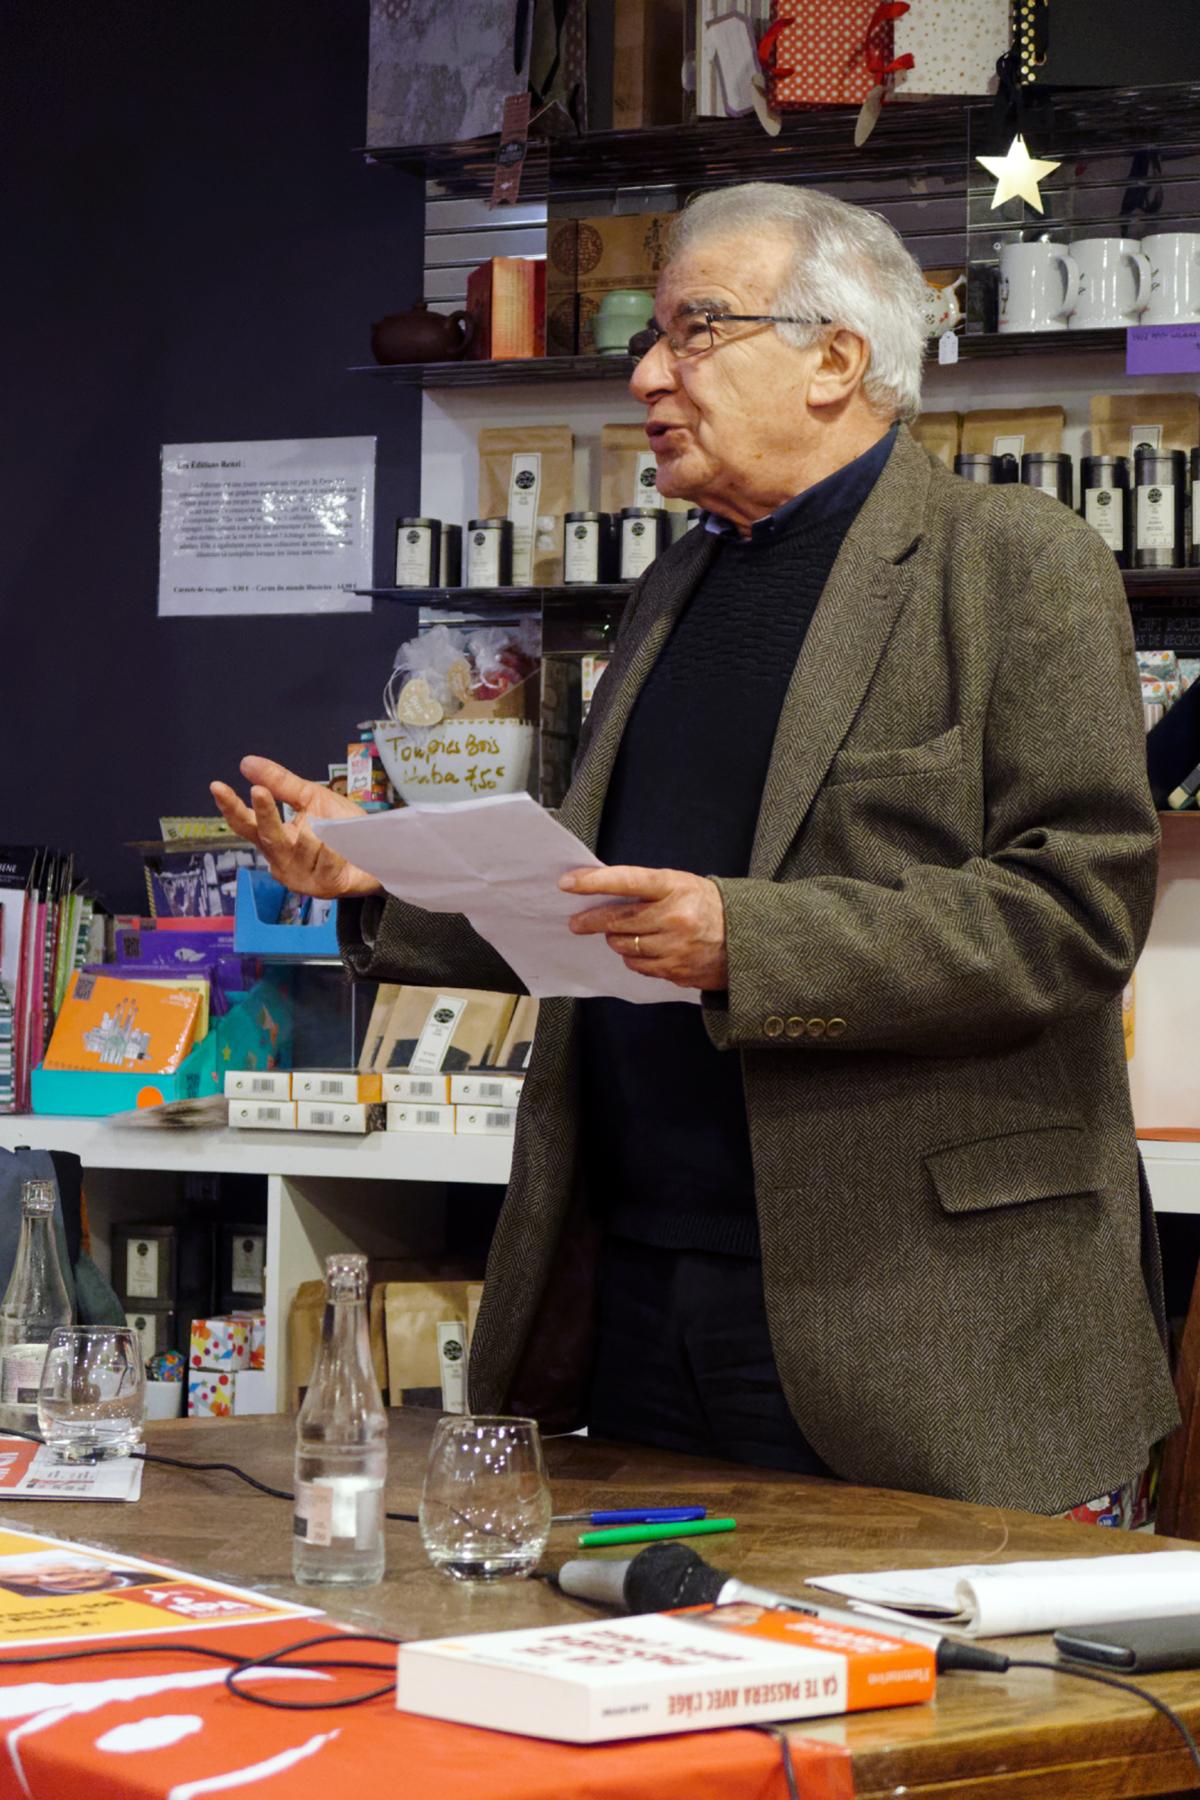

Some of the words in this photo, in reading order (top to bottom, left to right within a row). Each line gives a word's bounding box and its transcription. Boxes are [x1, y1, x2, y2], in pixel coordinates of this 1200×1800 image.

[743, 1680, 800, 1706] PASSERA
[805, 1677, 818, 1700] TE
[822, 1674, 839, 1698] ÇA
[707, 1687, 740, 1712] AVEC
